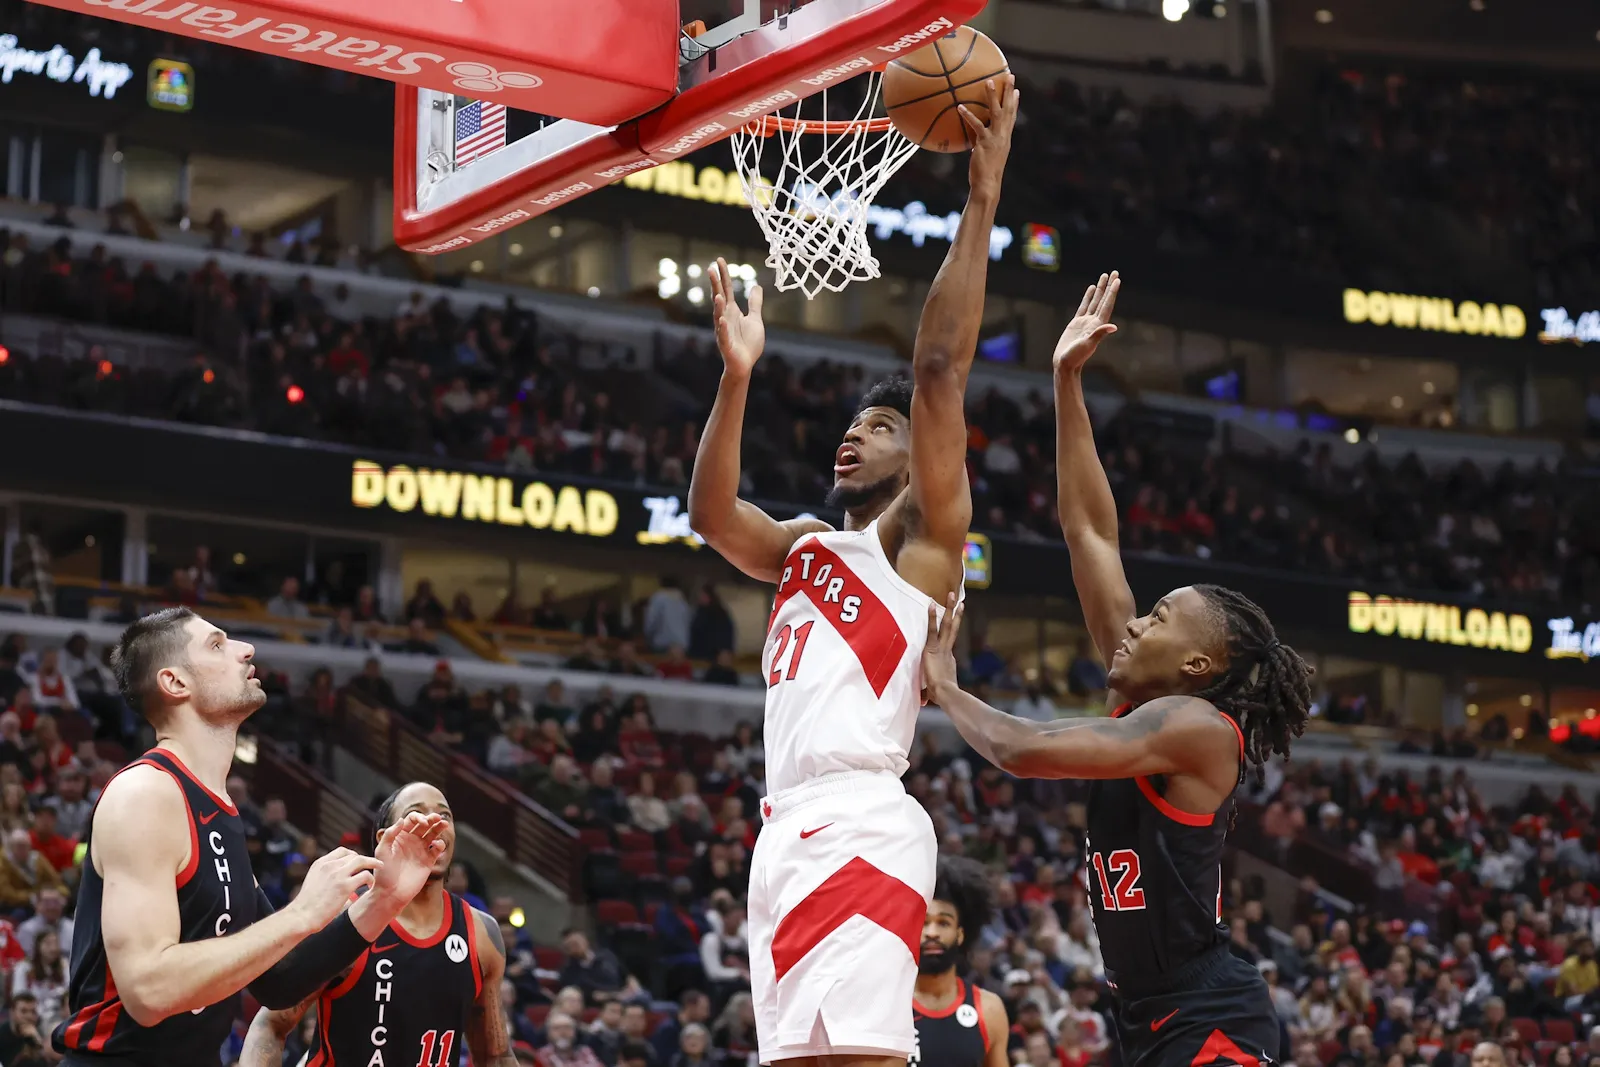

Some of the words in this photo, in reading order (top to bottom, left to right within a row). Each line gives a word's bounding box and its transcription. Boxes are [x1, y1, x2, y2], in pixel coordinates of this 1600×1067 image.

[471, 208, 531, 233] betway
[531, 180, 594, 206] betway
[595, 158, 659, 178] betway
[661, 121, 727, 154] betway
[728, 88, 798, 119] betway
[800, 55, 873, 86] betway
[877, 16, 954, 53] betway
[1343, 287, 1527, 339] DOWNLOAD
[352, 459, 618, 536] DOWNLOAD
[1348, 591, 1533, 653] DOWNLOAD
[769, 620, 815, 689] 21
[1092, 849, 1146, 911] 12
[416, 1029, 455, 1067] 11
